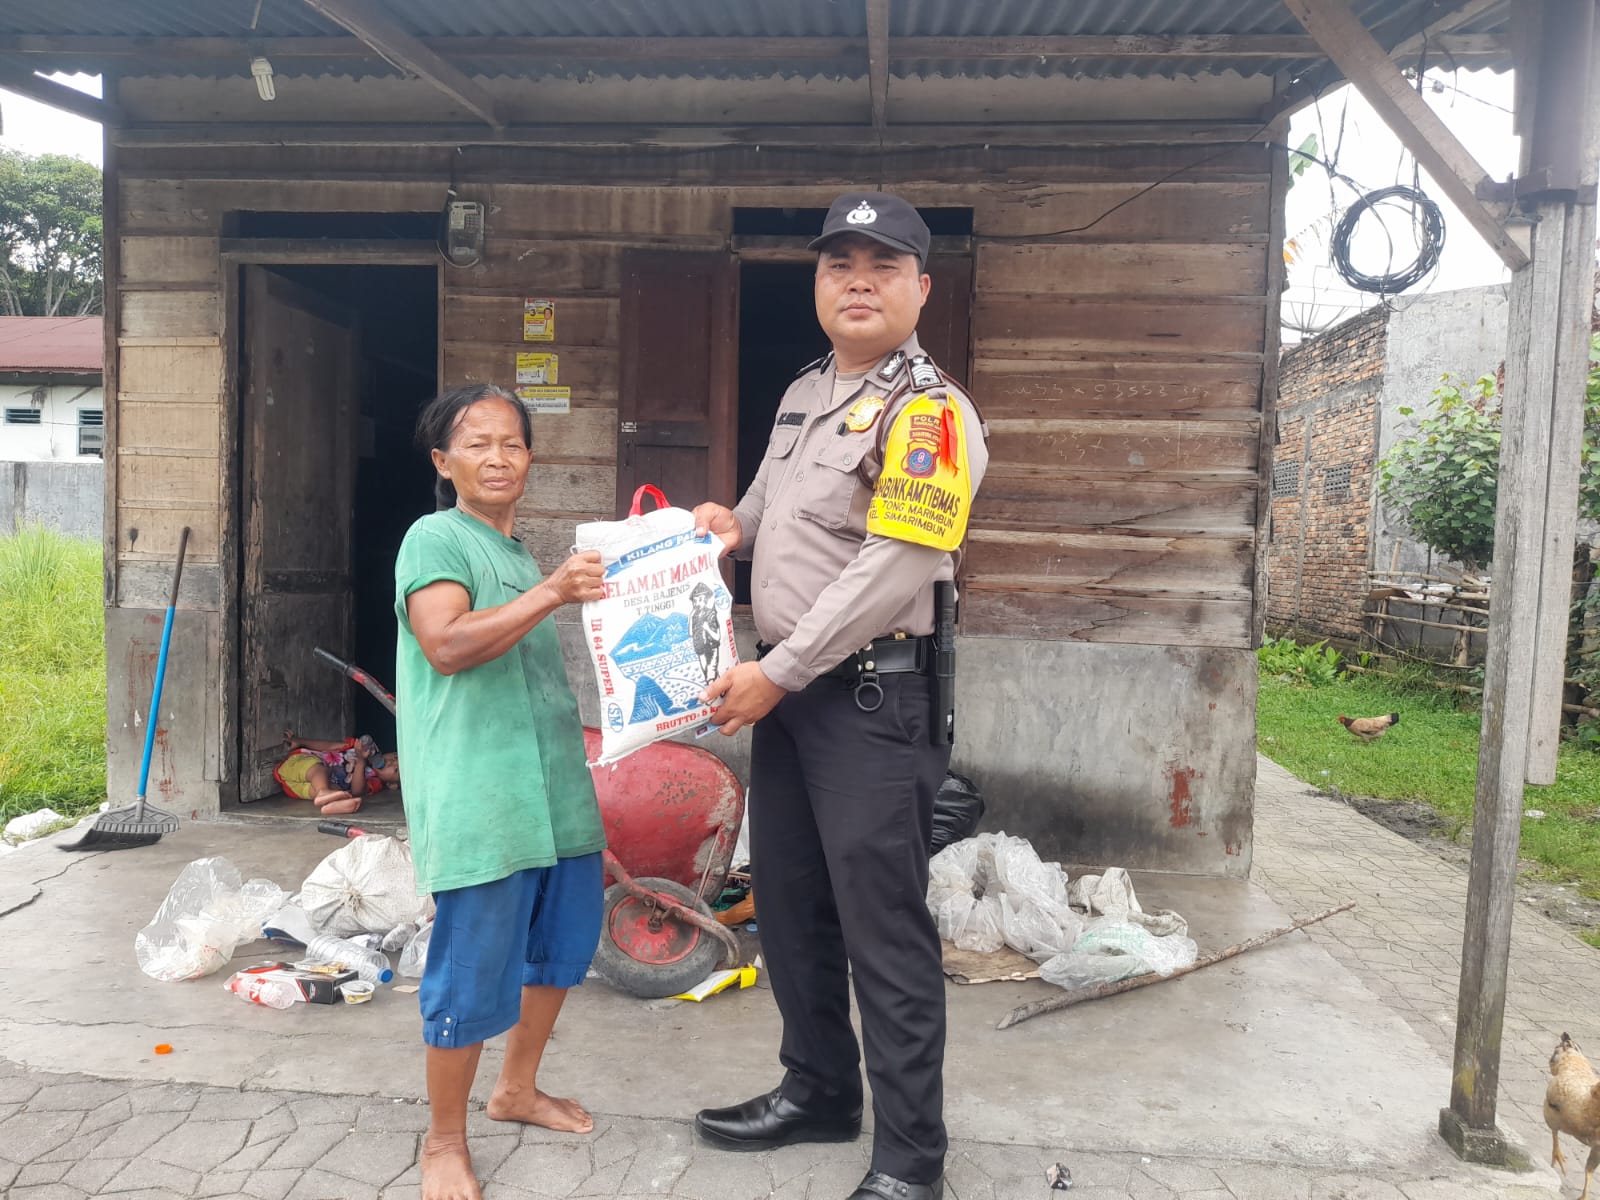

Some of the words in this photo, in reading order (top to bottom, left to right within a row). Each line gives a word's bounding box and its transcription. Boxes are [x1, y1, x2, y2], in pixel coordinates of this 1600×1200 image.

[914, 415, 940, 426] POLR
[883, 511, 946, 538] SIMARIMBUN
[908, 504, 955, 530] MARIMBUN
[627, 539, 673, 562] KILANG
[624, 594, 650, 608] DESA
[653, 582, 691, 602] BAJENIS
[644, 599, 675, 615] TINGGI
[597, 653, 615, 696] SUPER
